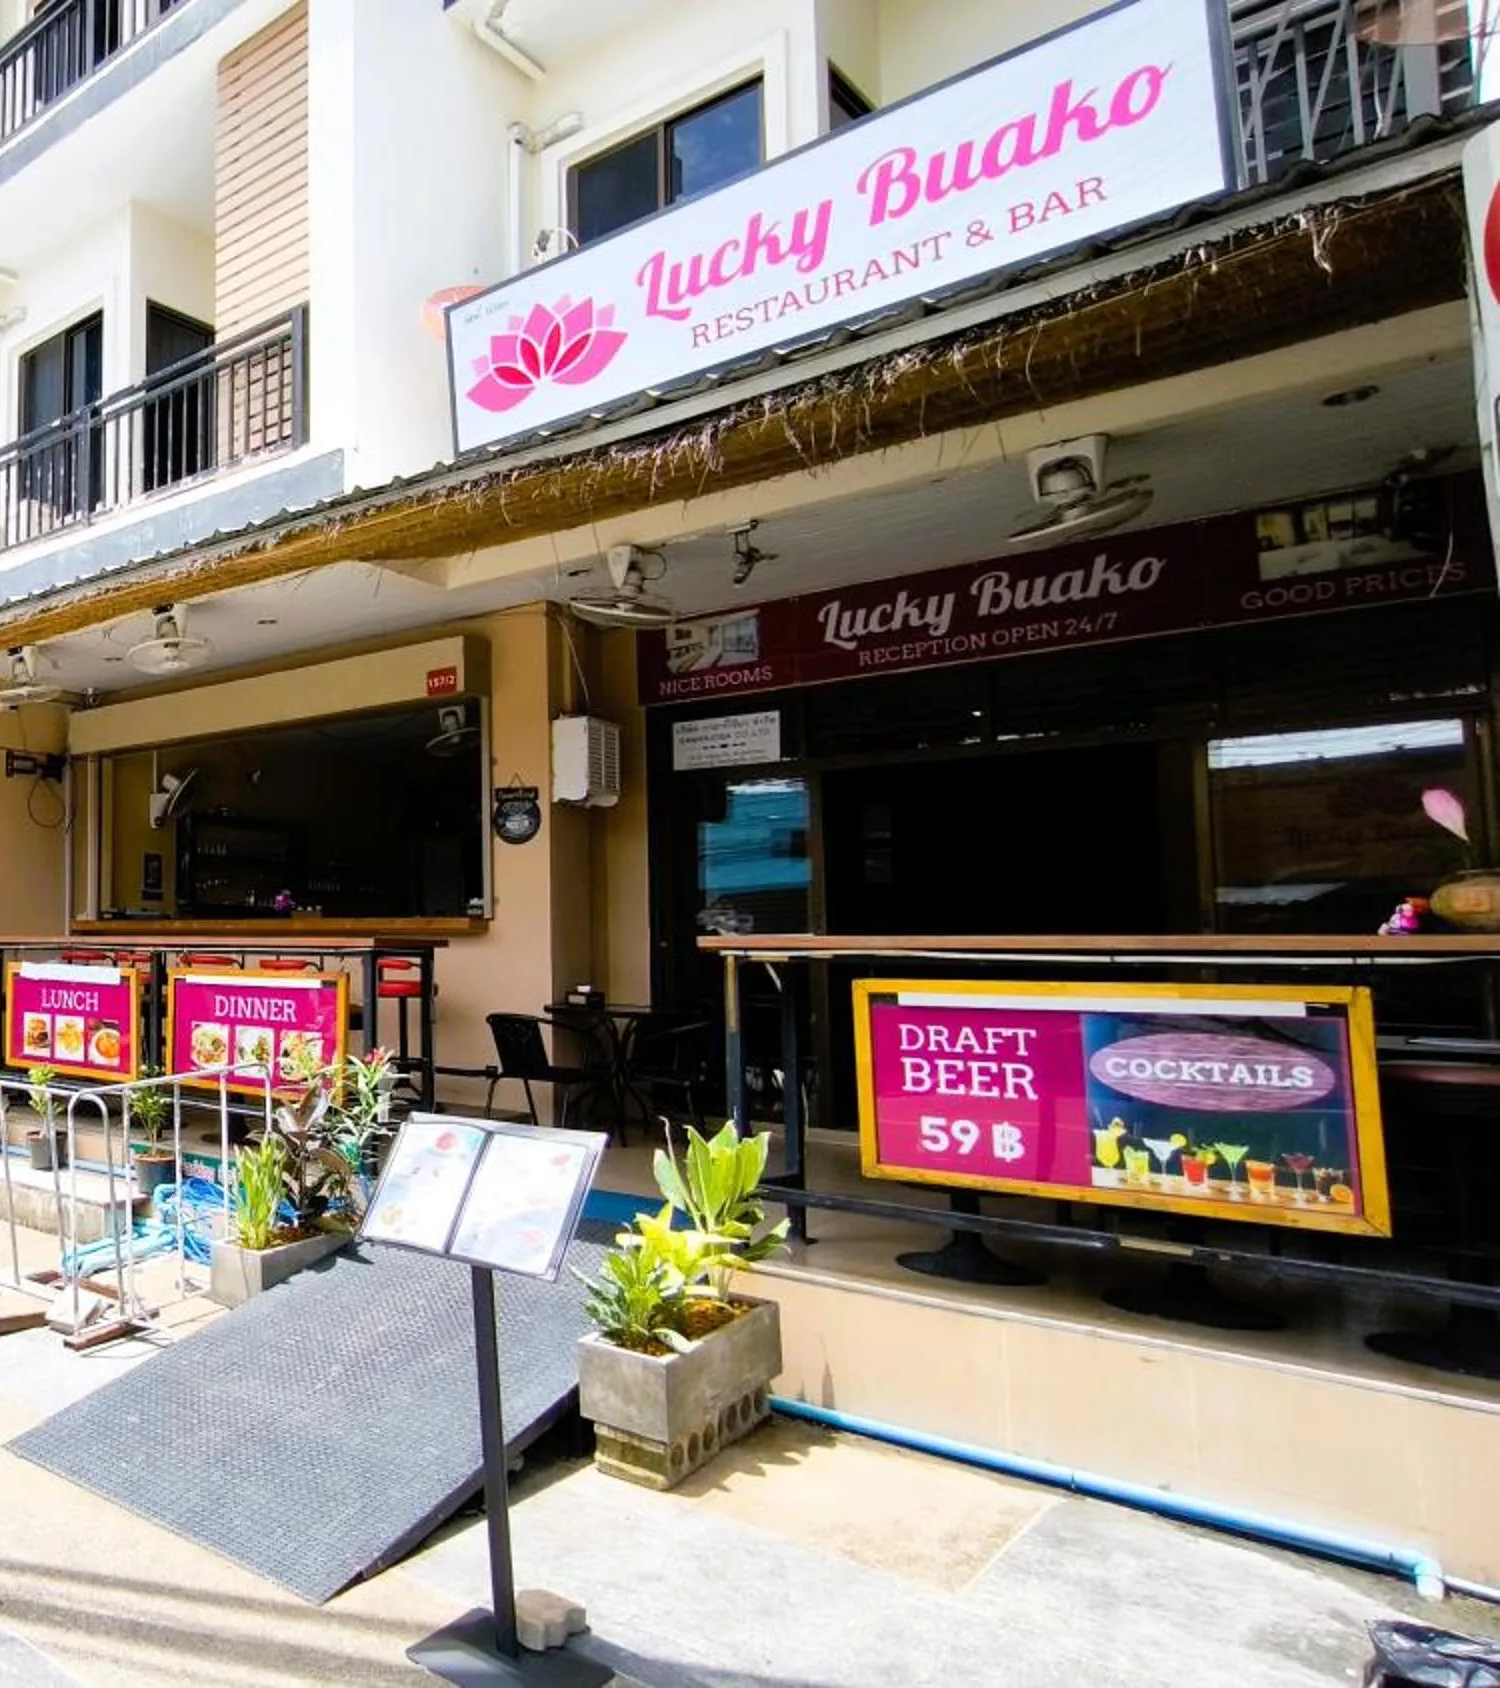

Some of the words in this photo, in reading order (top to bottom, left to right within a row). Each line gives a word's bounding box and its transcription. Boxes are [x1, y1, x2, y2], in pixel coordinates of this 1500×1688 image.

[636, 199, 833, 322] Lucky
[856, 61, 1175, 227] Buako
[690, 231, 952, 349] RESTAURANT
[965, 219, 994, 248] &
[1008, 175, 1109, 235] BAR
[818, 590, 956, 650] Lucky
[970, 553, 1167, 617] Buako
[1240, 580, 1335, 610] GOOD
[1345, 561, 1466, 596] PRICES
[859, 631, 987, 667] RECEPTION
[992, 621, 1059, 646] OPEN
[1065, 612, 1118, 636] 24/7
[660, 677, 701, 697] NICE
[704, 665, 773, 689] ROOMS
[41, 988, 99, 1012] LUNCH
[214, 994, 297, 1024] DINNER
[898, 1023, 1037, 1057] DRAFT
[900, 1057, 1039, 1101] BEER
[1105, 1057, 1315, 1089] COCKTAILS
[920, 1116, 979, 1156] 59
